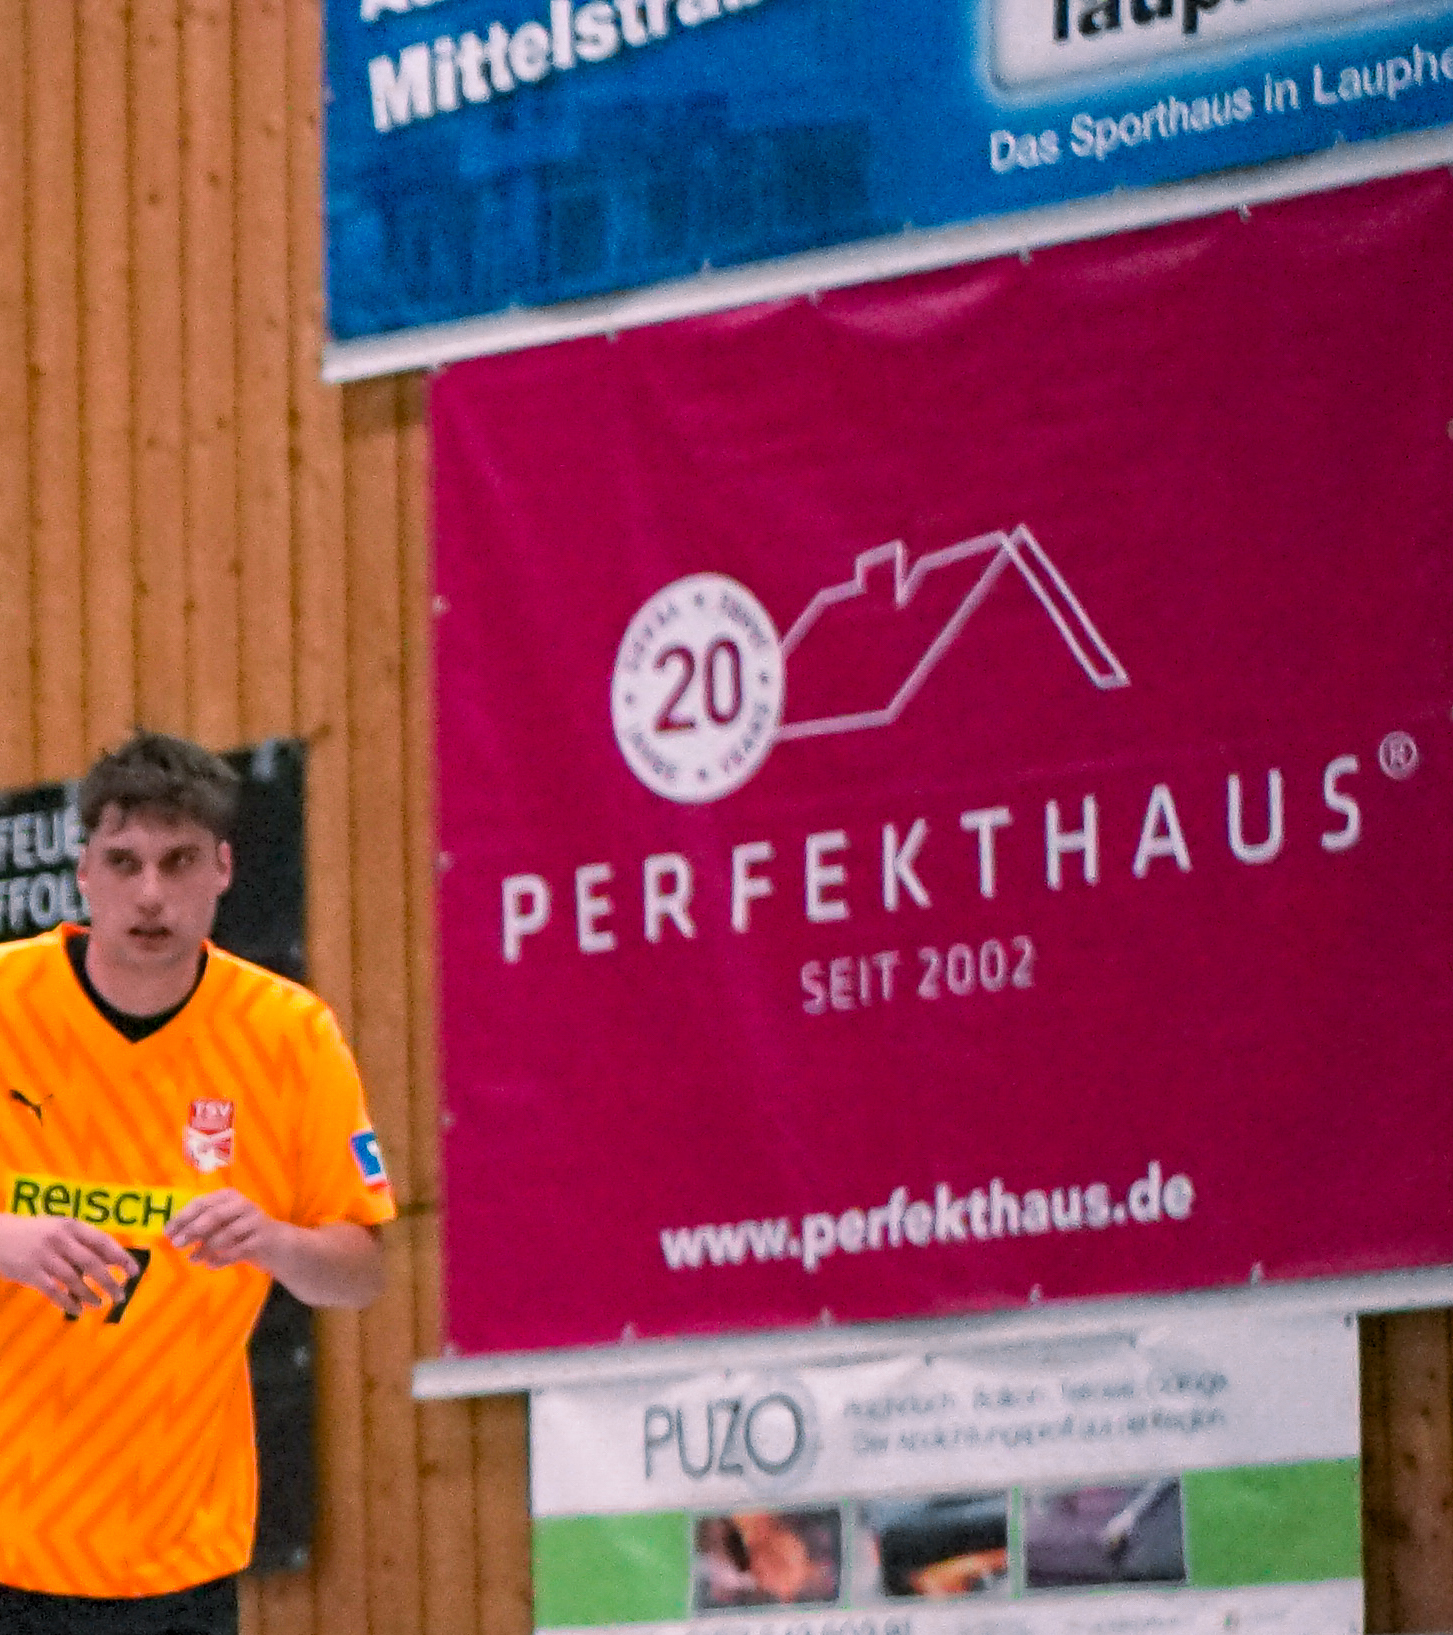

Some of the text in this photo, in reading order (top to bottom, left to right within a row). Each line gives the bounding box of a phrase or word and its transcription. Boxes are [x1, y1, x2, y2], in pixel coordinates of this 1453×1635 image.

[989, 129, 1060, 173] Das
[1070, 87, 1254, 161] Sporthaus
[1264, 72, 1300, 113] in
[654, 634, 744, 734] 20
[801, 935, 1037, 1015] SEIT 2002
[659, 1160, 1197, 1272] www.perfekthaus.de
[644, 1391, 806, 1480] PUZO
